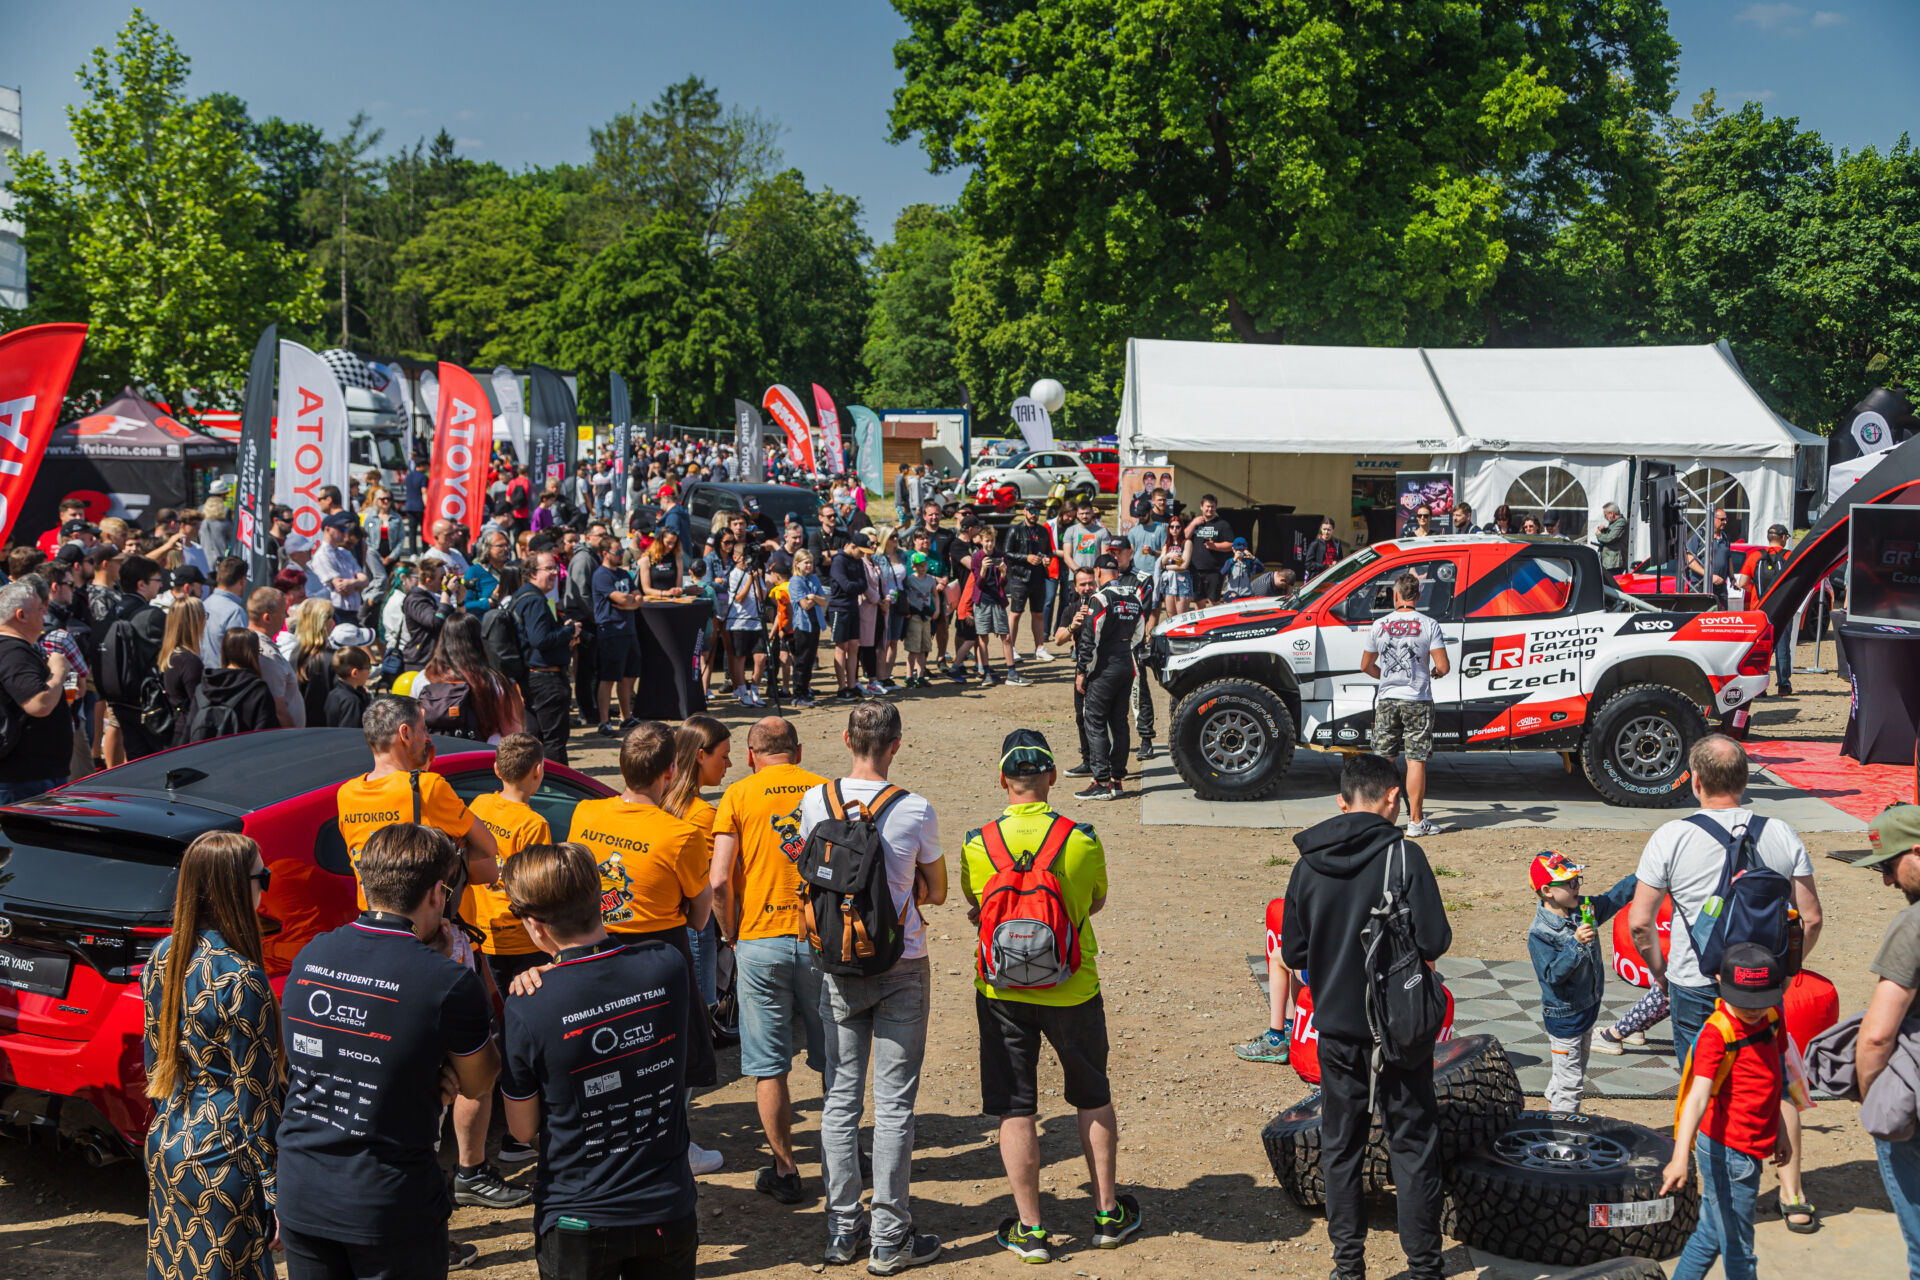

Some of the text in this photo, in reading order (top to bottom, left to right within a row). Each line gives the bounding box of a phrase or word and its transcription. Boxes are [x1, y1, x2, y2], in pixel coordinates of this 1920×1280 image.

[1634, 620, 1673, 631] NEXO
[1698, 616, 1744, 625] TOYOTA
[1530, 626, 1604, 641] TOYOTA
[1530, 636, 1598, 653] GAZOO
[1462, 647, 1523, 671] GR
[1529, 649, 1596, 665] Racing
[1488, 668, 1576, 691] Czech
[1473, 725, 1506, 735] Fortelock
[344, 810, 400, 824] AUTOKROS
[580, 828, 650, 854] AUTOKROS
[11, 957, 35, 972] YARIS
[304, 964, 399, 992] FORMULA STUDENT TEAM
[337, 1005, 368, 1020] CTU
[562, 987, 666, 1025] FORMULA STUDENT TEAM
[329, 1014, 366, 1027] CARTECH
[623, 1023, 653, 1040] CTU
[619, 1033, 655, 1049] CARTECH
